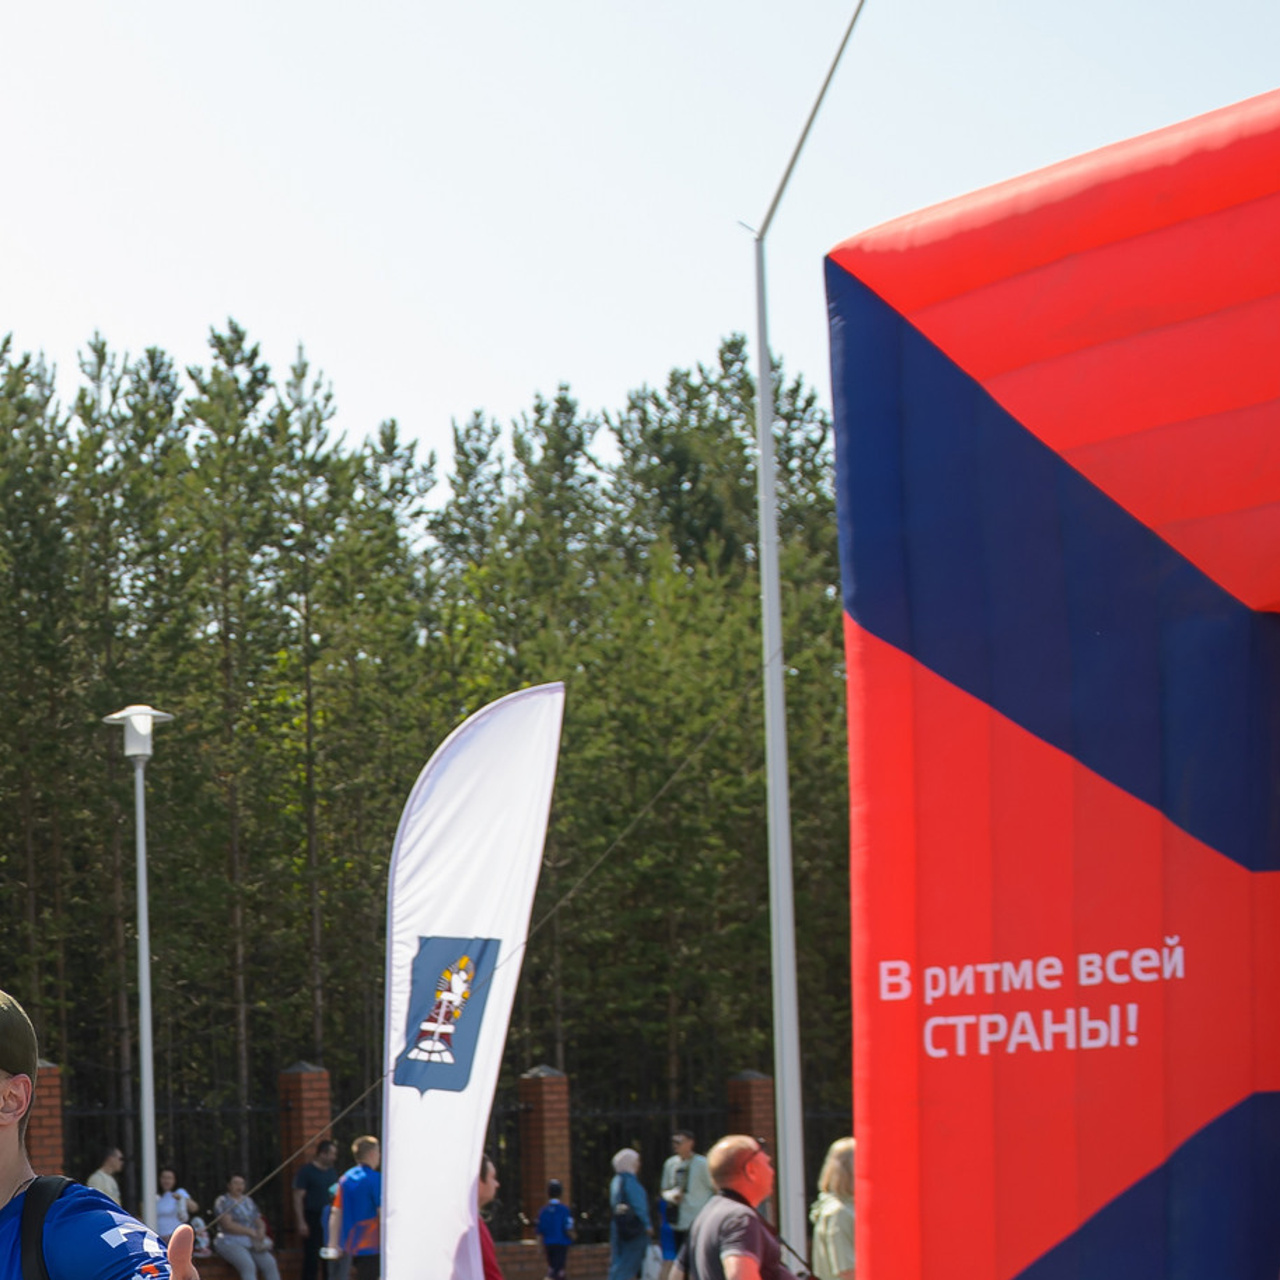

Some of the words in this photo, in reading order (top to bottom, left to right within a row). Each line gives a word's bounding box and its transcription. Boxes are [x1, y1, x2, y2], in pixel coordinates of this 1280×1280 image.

[879, 960, 912, 1001] В
[924, 955, 1063, 1005] ритме
[1078, 935, 1184, 986] всей
[924, 1003, 1138, 1058] СТРАНЫ!
